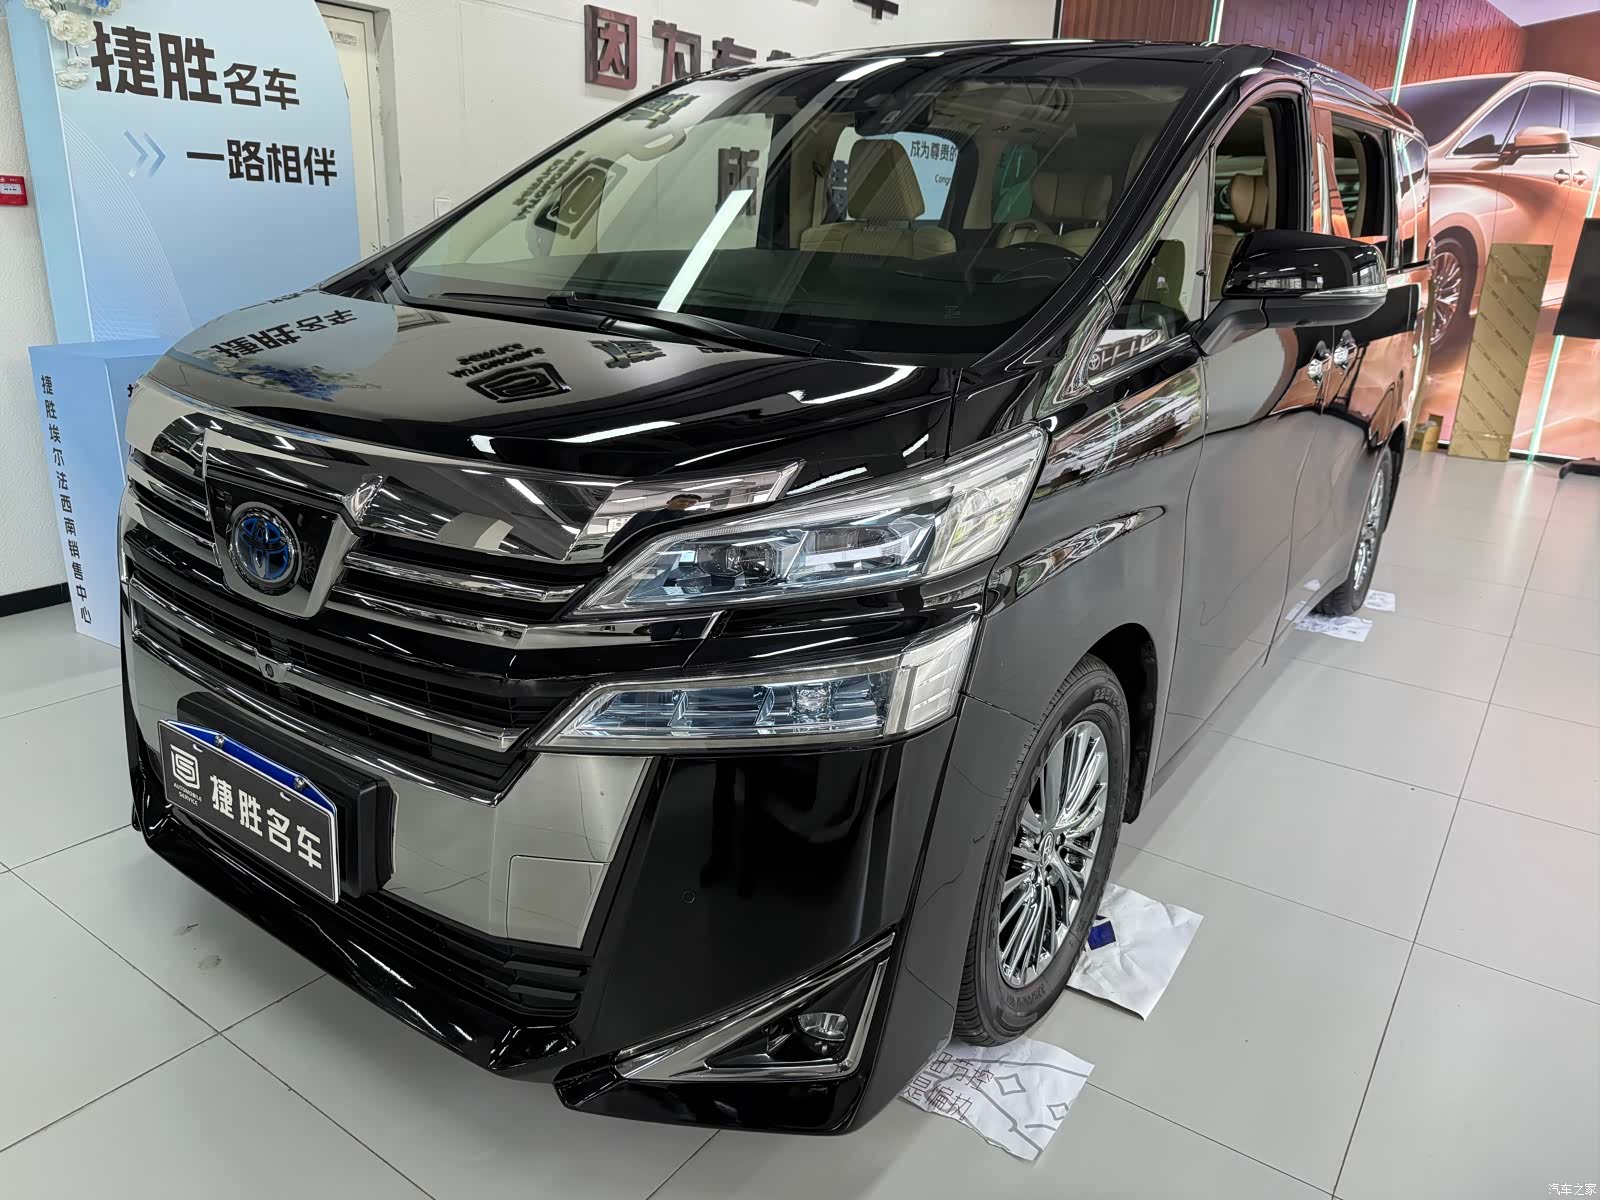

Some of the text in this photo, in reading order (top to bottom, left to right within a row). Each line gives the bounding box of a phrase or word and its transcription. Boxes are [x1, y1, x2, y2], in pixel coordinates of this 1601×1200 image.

[90, 21, 300, 110] 捷胜名车
[186, 139, 338, 187] 一路相伴
[41, 374, 92, 624] 捷胜埃尔法西南销售中心
[173, 782, 202, 803] AUTOMOBILE
[178, 791, 198, 806] SERVICE
[210, 774, 322, 870] 捷胜名车
